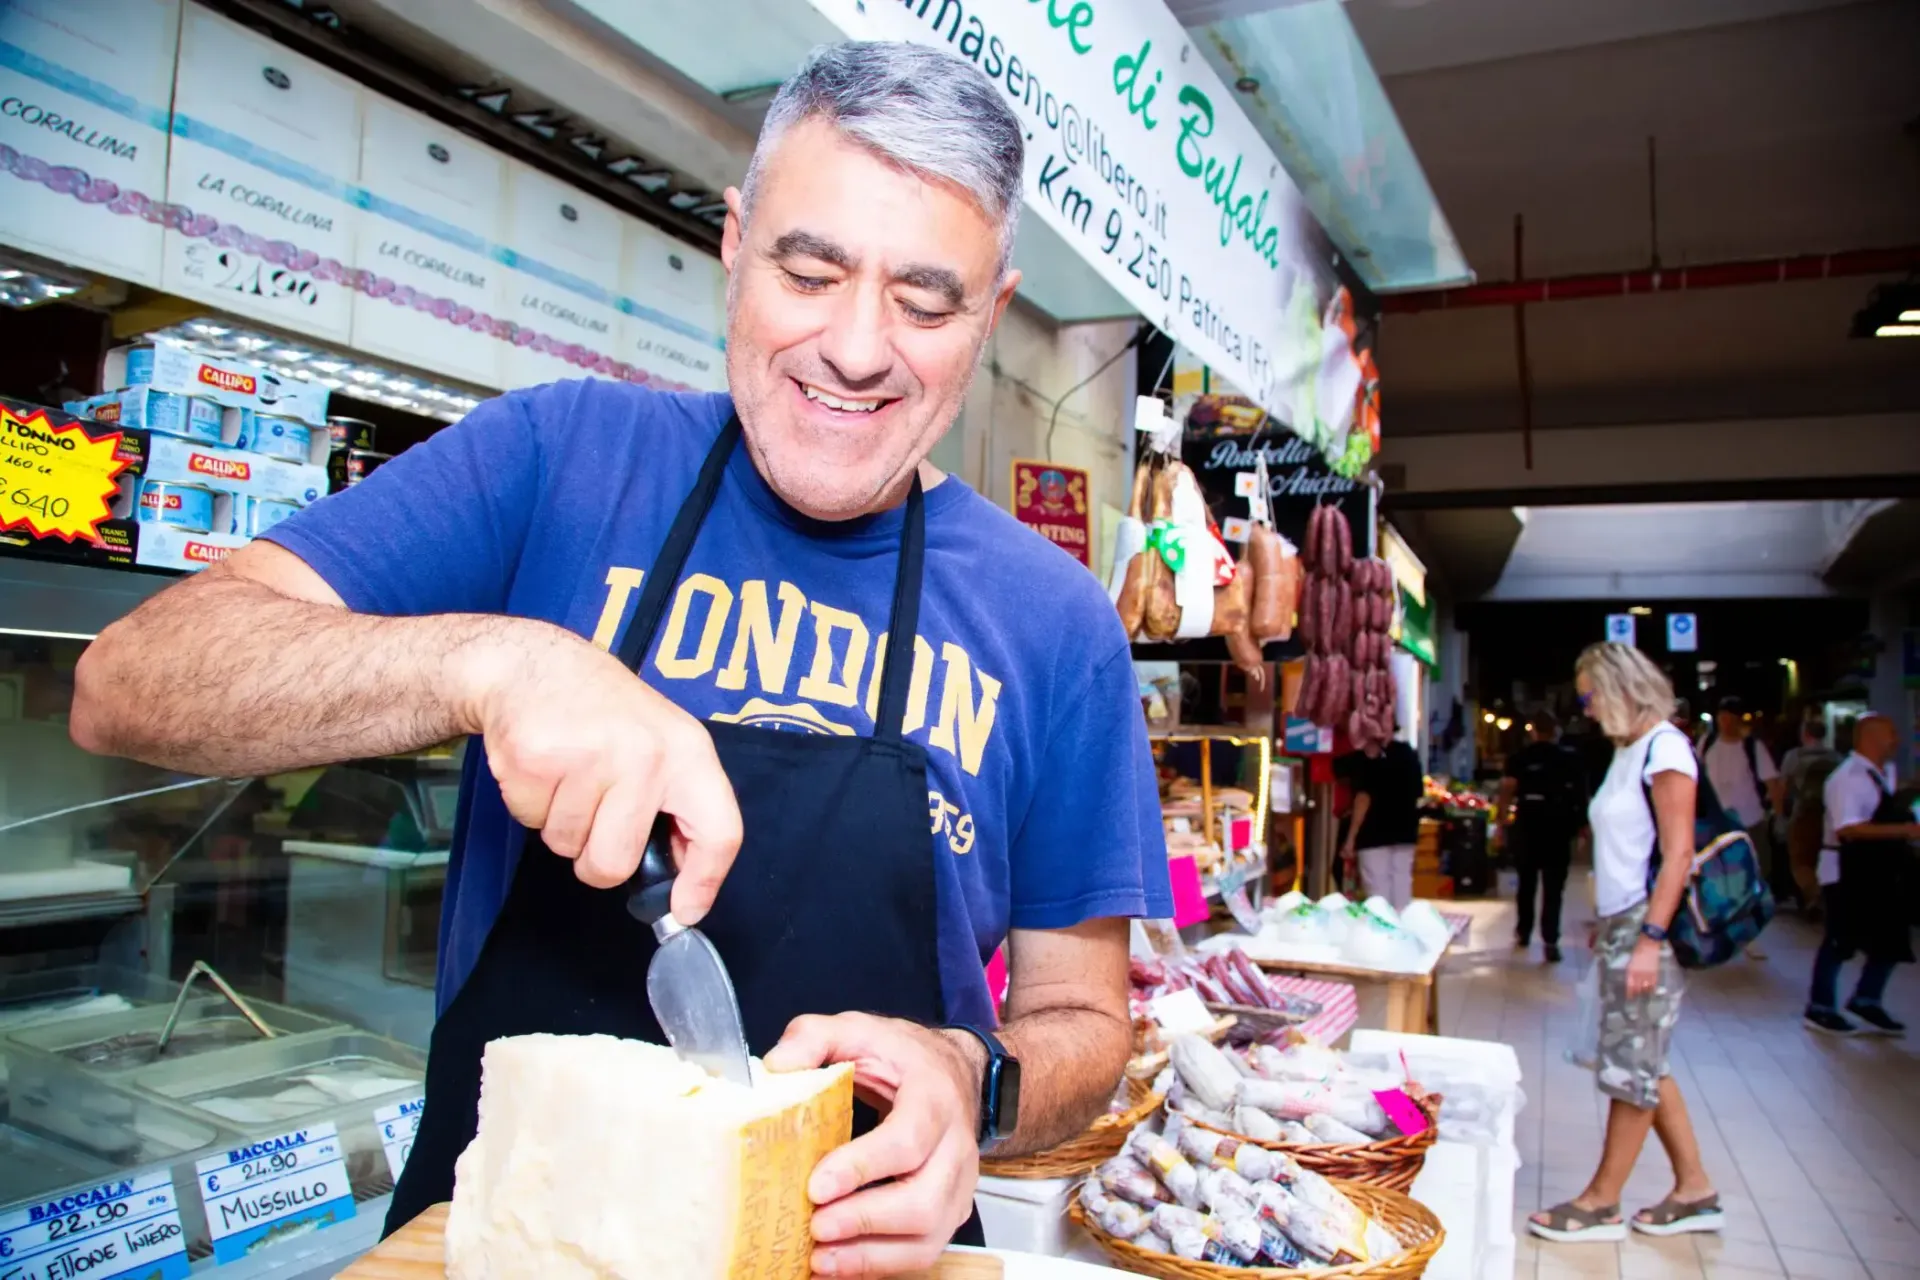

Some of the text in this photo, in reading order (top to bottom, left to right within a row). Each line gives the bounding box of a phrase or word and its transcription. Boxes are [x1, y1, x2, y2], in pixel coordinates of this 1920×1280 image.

[0, 97, 138, 162] CORALLINA
[904, 0, 1168, 241] maseno@libero.it
[1113, 39, 1163, 131] di
[1175, 84, 1279, 270] Bufala
[197, 173, 334, 233] LA CORALLINA
[378, 240, 487, 289] LA CORALLINA
[1039, 154, 1093, 235] Km
[1101, 207, 1172, 301] 9.250
[1178, 274, 1242, 363] Patrica
[520, 293, 609, 335] LA CORALLINA
[203, 367, 254, 391] CALLIPO
[0, 436, 49, 456] LLIPO
[5, 418, 75, 451] TONNO
[194, 457, 246, 478] CALLIPO
[591, 566, 1003, 777] LONDON
[399, 1098, 425, 1115] BAC
[227, 1130, 308, 1164] BACCALA'
[207, 1152, 298, 1192] € 24.90
[28, 1178, 135, 1223] BACCALA'
[219, 1182, 328, 1230] MUSSILLO
[0, 1237, 15, 1258] €
[48, 1202, 129, 1241] 22,90
